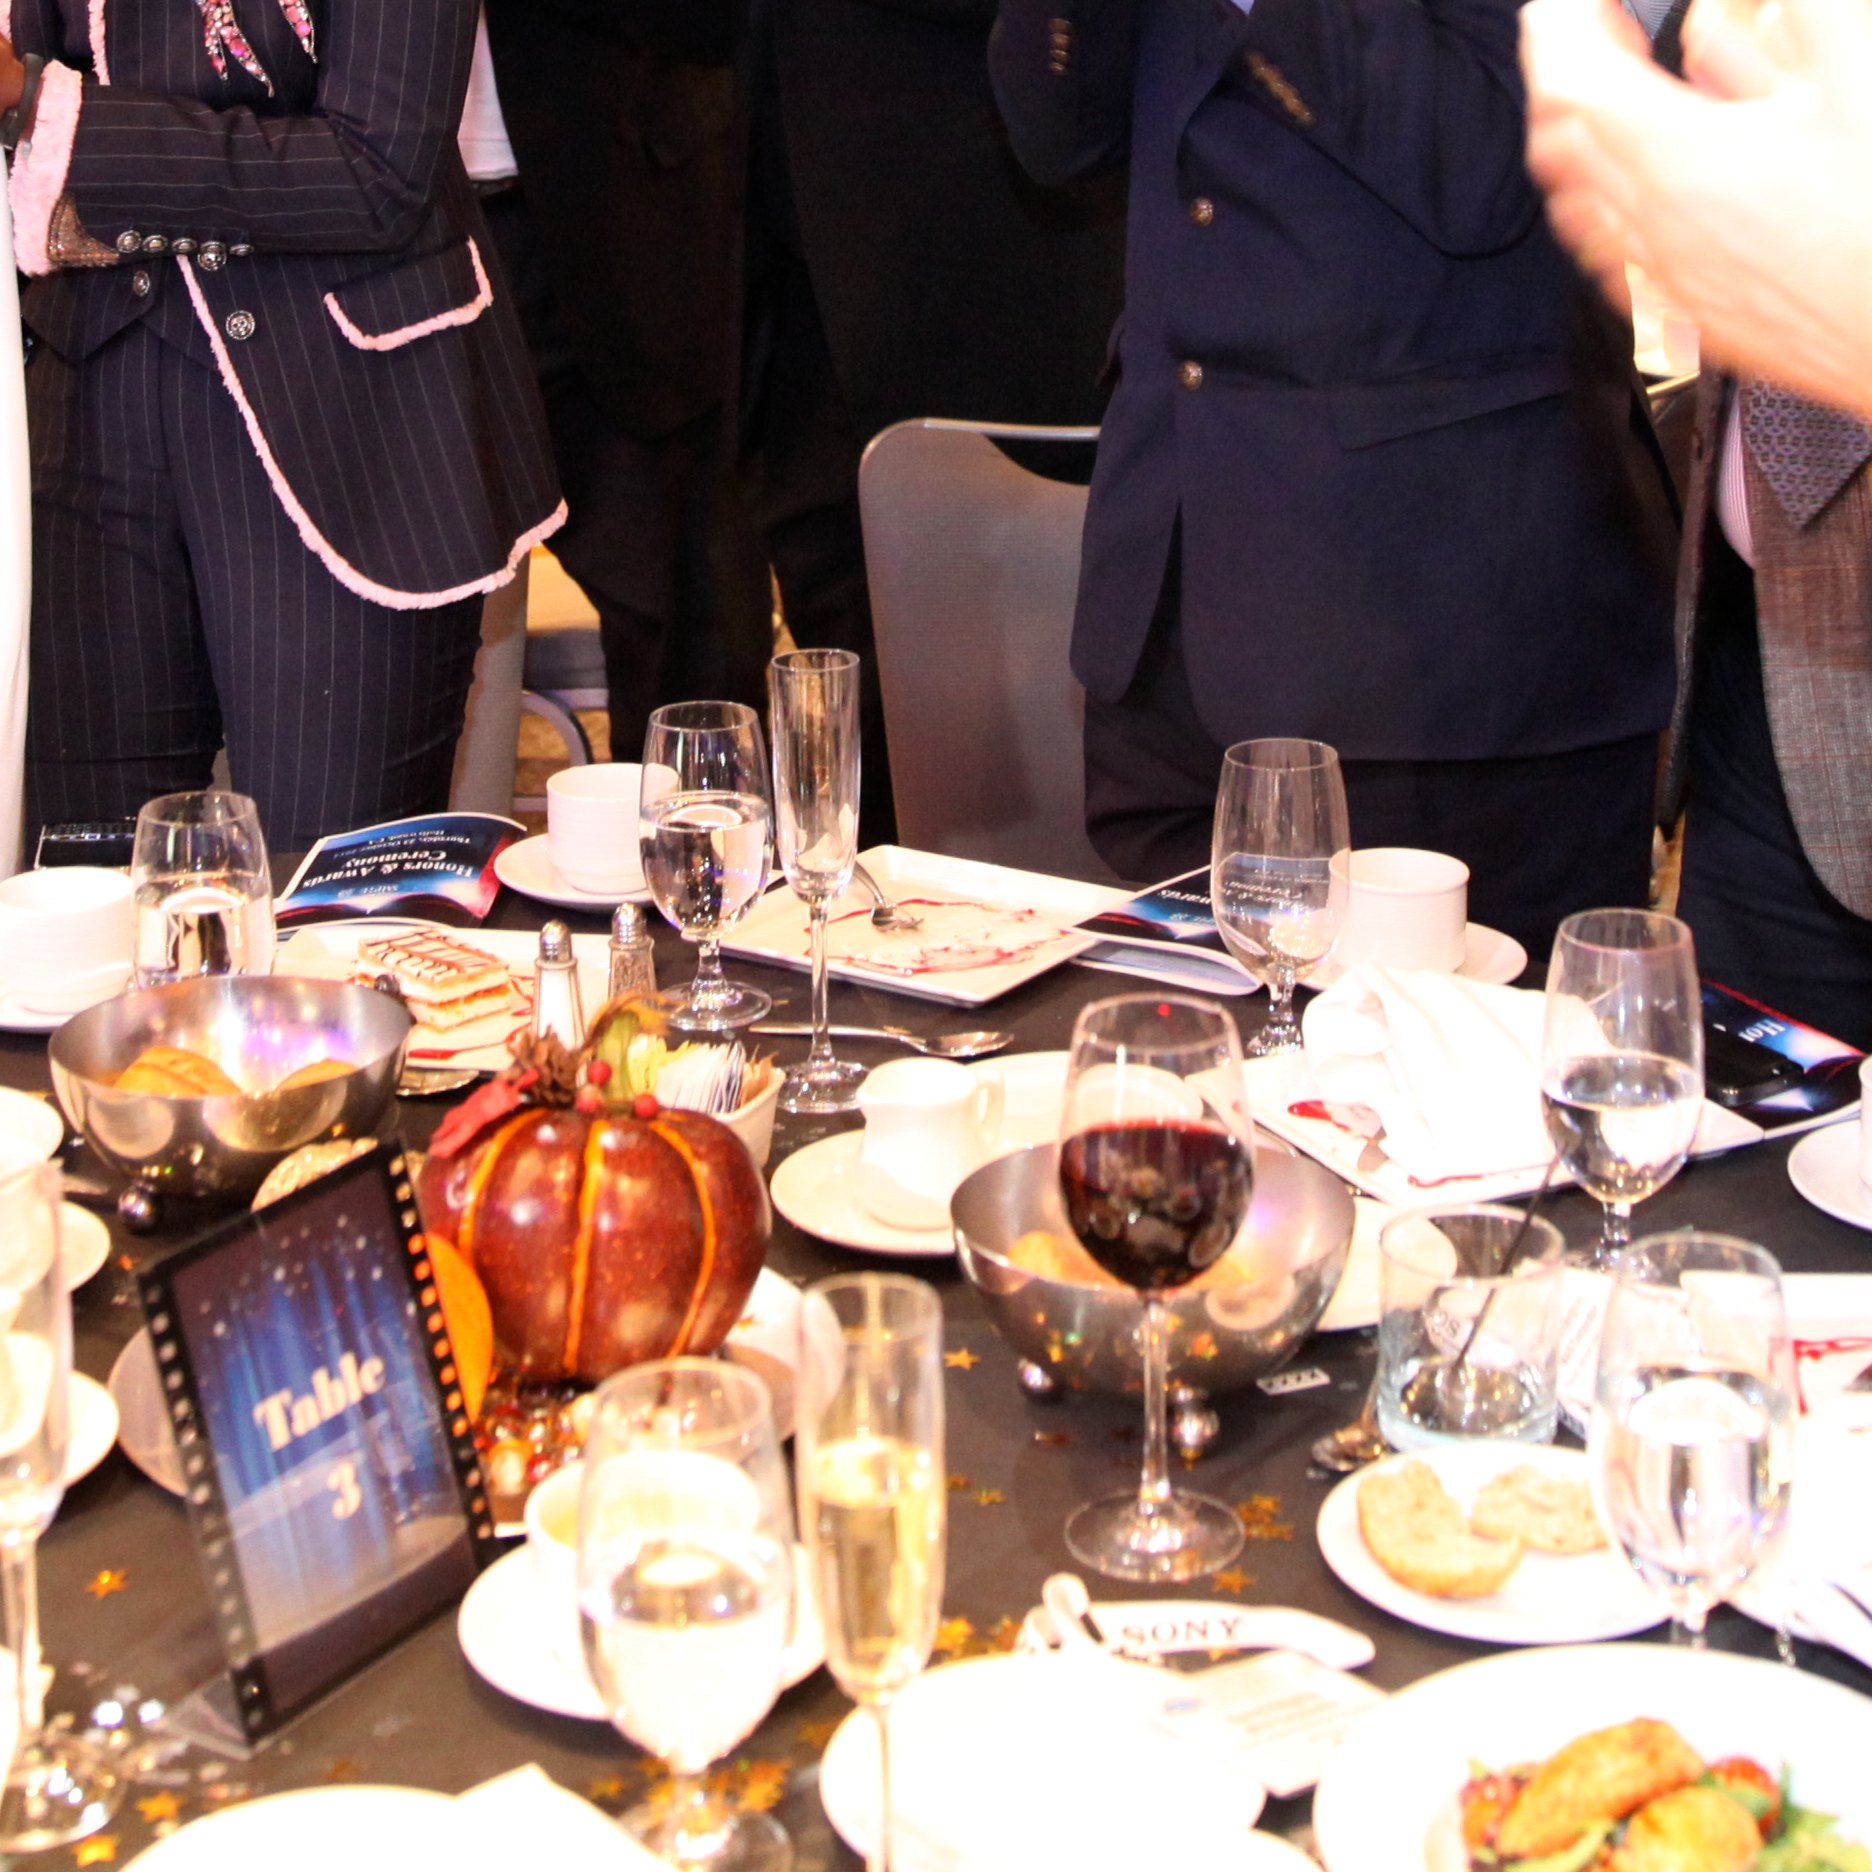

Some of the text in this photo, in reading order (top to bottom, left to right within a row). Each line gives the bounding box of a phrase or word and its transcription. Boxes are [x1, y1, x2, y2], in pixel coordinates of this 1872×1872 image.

[341, 850, 447, 869] Ceremony
[303, 860, 474, 888] Honors & Awards
[1157, 889, 1214, 905] wards
[254, 1351, 386, 1450] Table
[327, 1459, 362, 1519] 3
[1121, 1617, 1243, 1644] SONY
